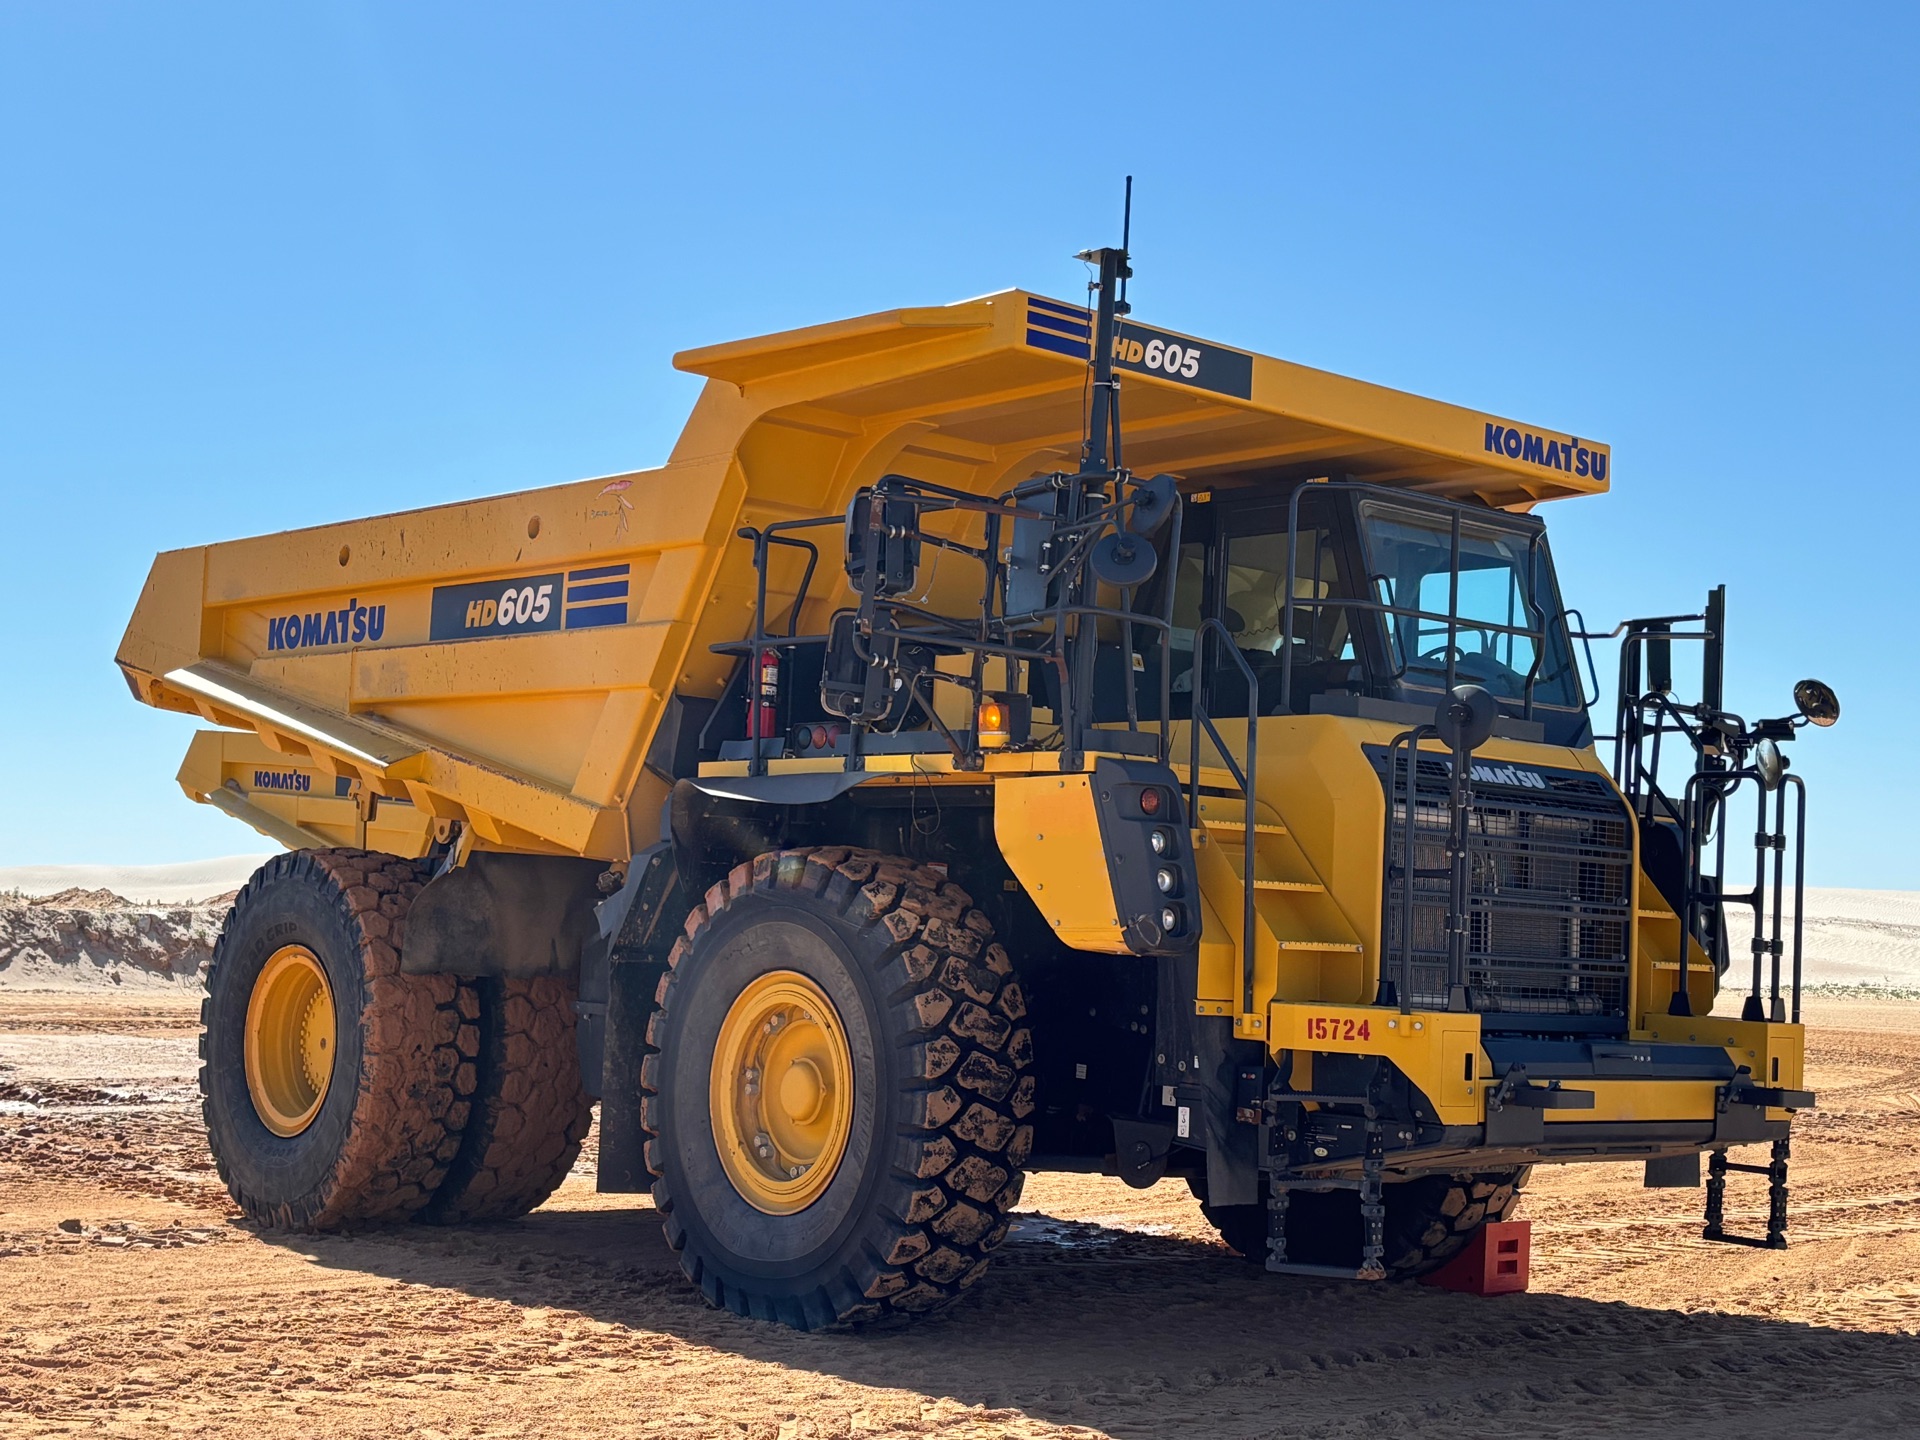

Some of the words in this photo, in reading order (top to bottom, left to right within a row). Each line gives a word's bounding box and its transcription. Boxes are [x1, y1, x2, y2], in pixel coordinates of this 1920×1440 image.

[1111, 336, 1201, 379] HD605
[1484, 422, 1606, 481] KOMATSU
[267, 598, 385, 650] KOMATSU
[465, 584, 553, 628] HD605
[254, 768, 311, 792] KOMATSU
[1307, 1017, 1371, 1042] 15724
